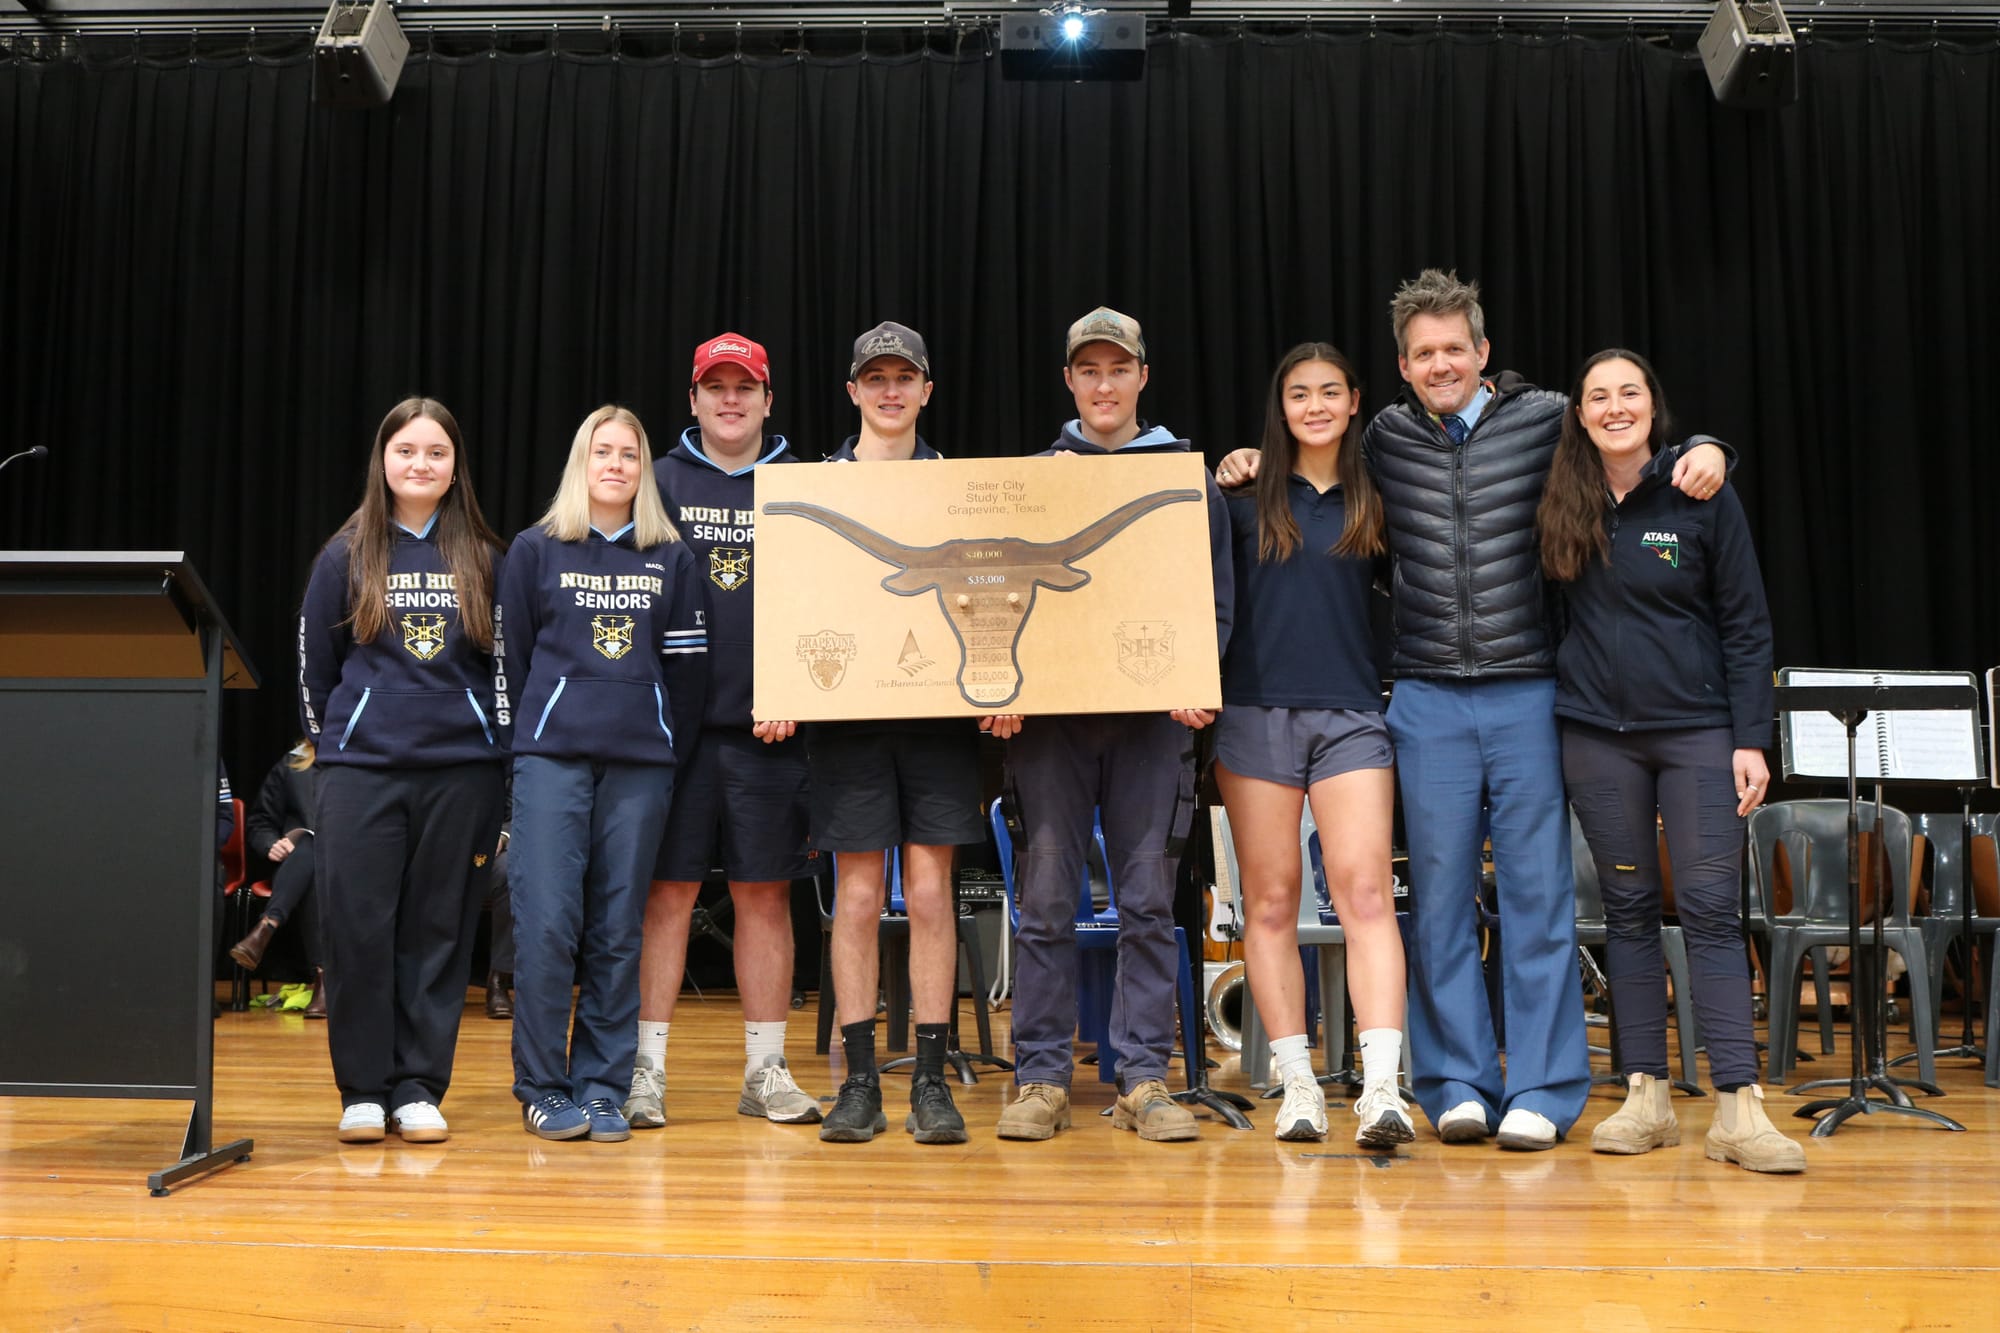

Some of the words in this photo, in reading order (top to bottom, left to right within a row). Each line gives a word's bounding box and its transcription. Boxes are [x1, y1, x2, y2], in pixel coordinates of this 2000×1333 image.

[967, 480, 1000, 491] Sister
[1003, 480, 1025, 491] City
[966, 492, 999, 504] Study
[1002, 491, 1028, 502] Tour
[680, 506, 730, 524] NURI
[734, 509, 755, 526] HI
[947, 504, 1010, 516] Grapevine,
[1014, 503, 1047, 513] Texas
[693, 524, 755, 543] SENIOR
[1642, 531, 1679, 543] ATASA
[965, 550, 1003, 560] $40,000
[386, 572, 422, 590] URI
[560, 572, 613, 592] NURI
[616, 574, 664, 596] HIGH
[967, 574, 1005, 585] $35,000
[384, 591, 461, 609] SENIORS
[575, 591, 652, 609] SENIORS
[798, 635, 856, 649] GRAPEVINE
[1121, 638, 1169, 658] NHS
[971, 652, 1008, 664] $15,000
[493, 604, 511, 726] SENIORS
[971, 670, 1009, 682] $10,000
[975, 687, 1007, 699] $5,000
